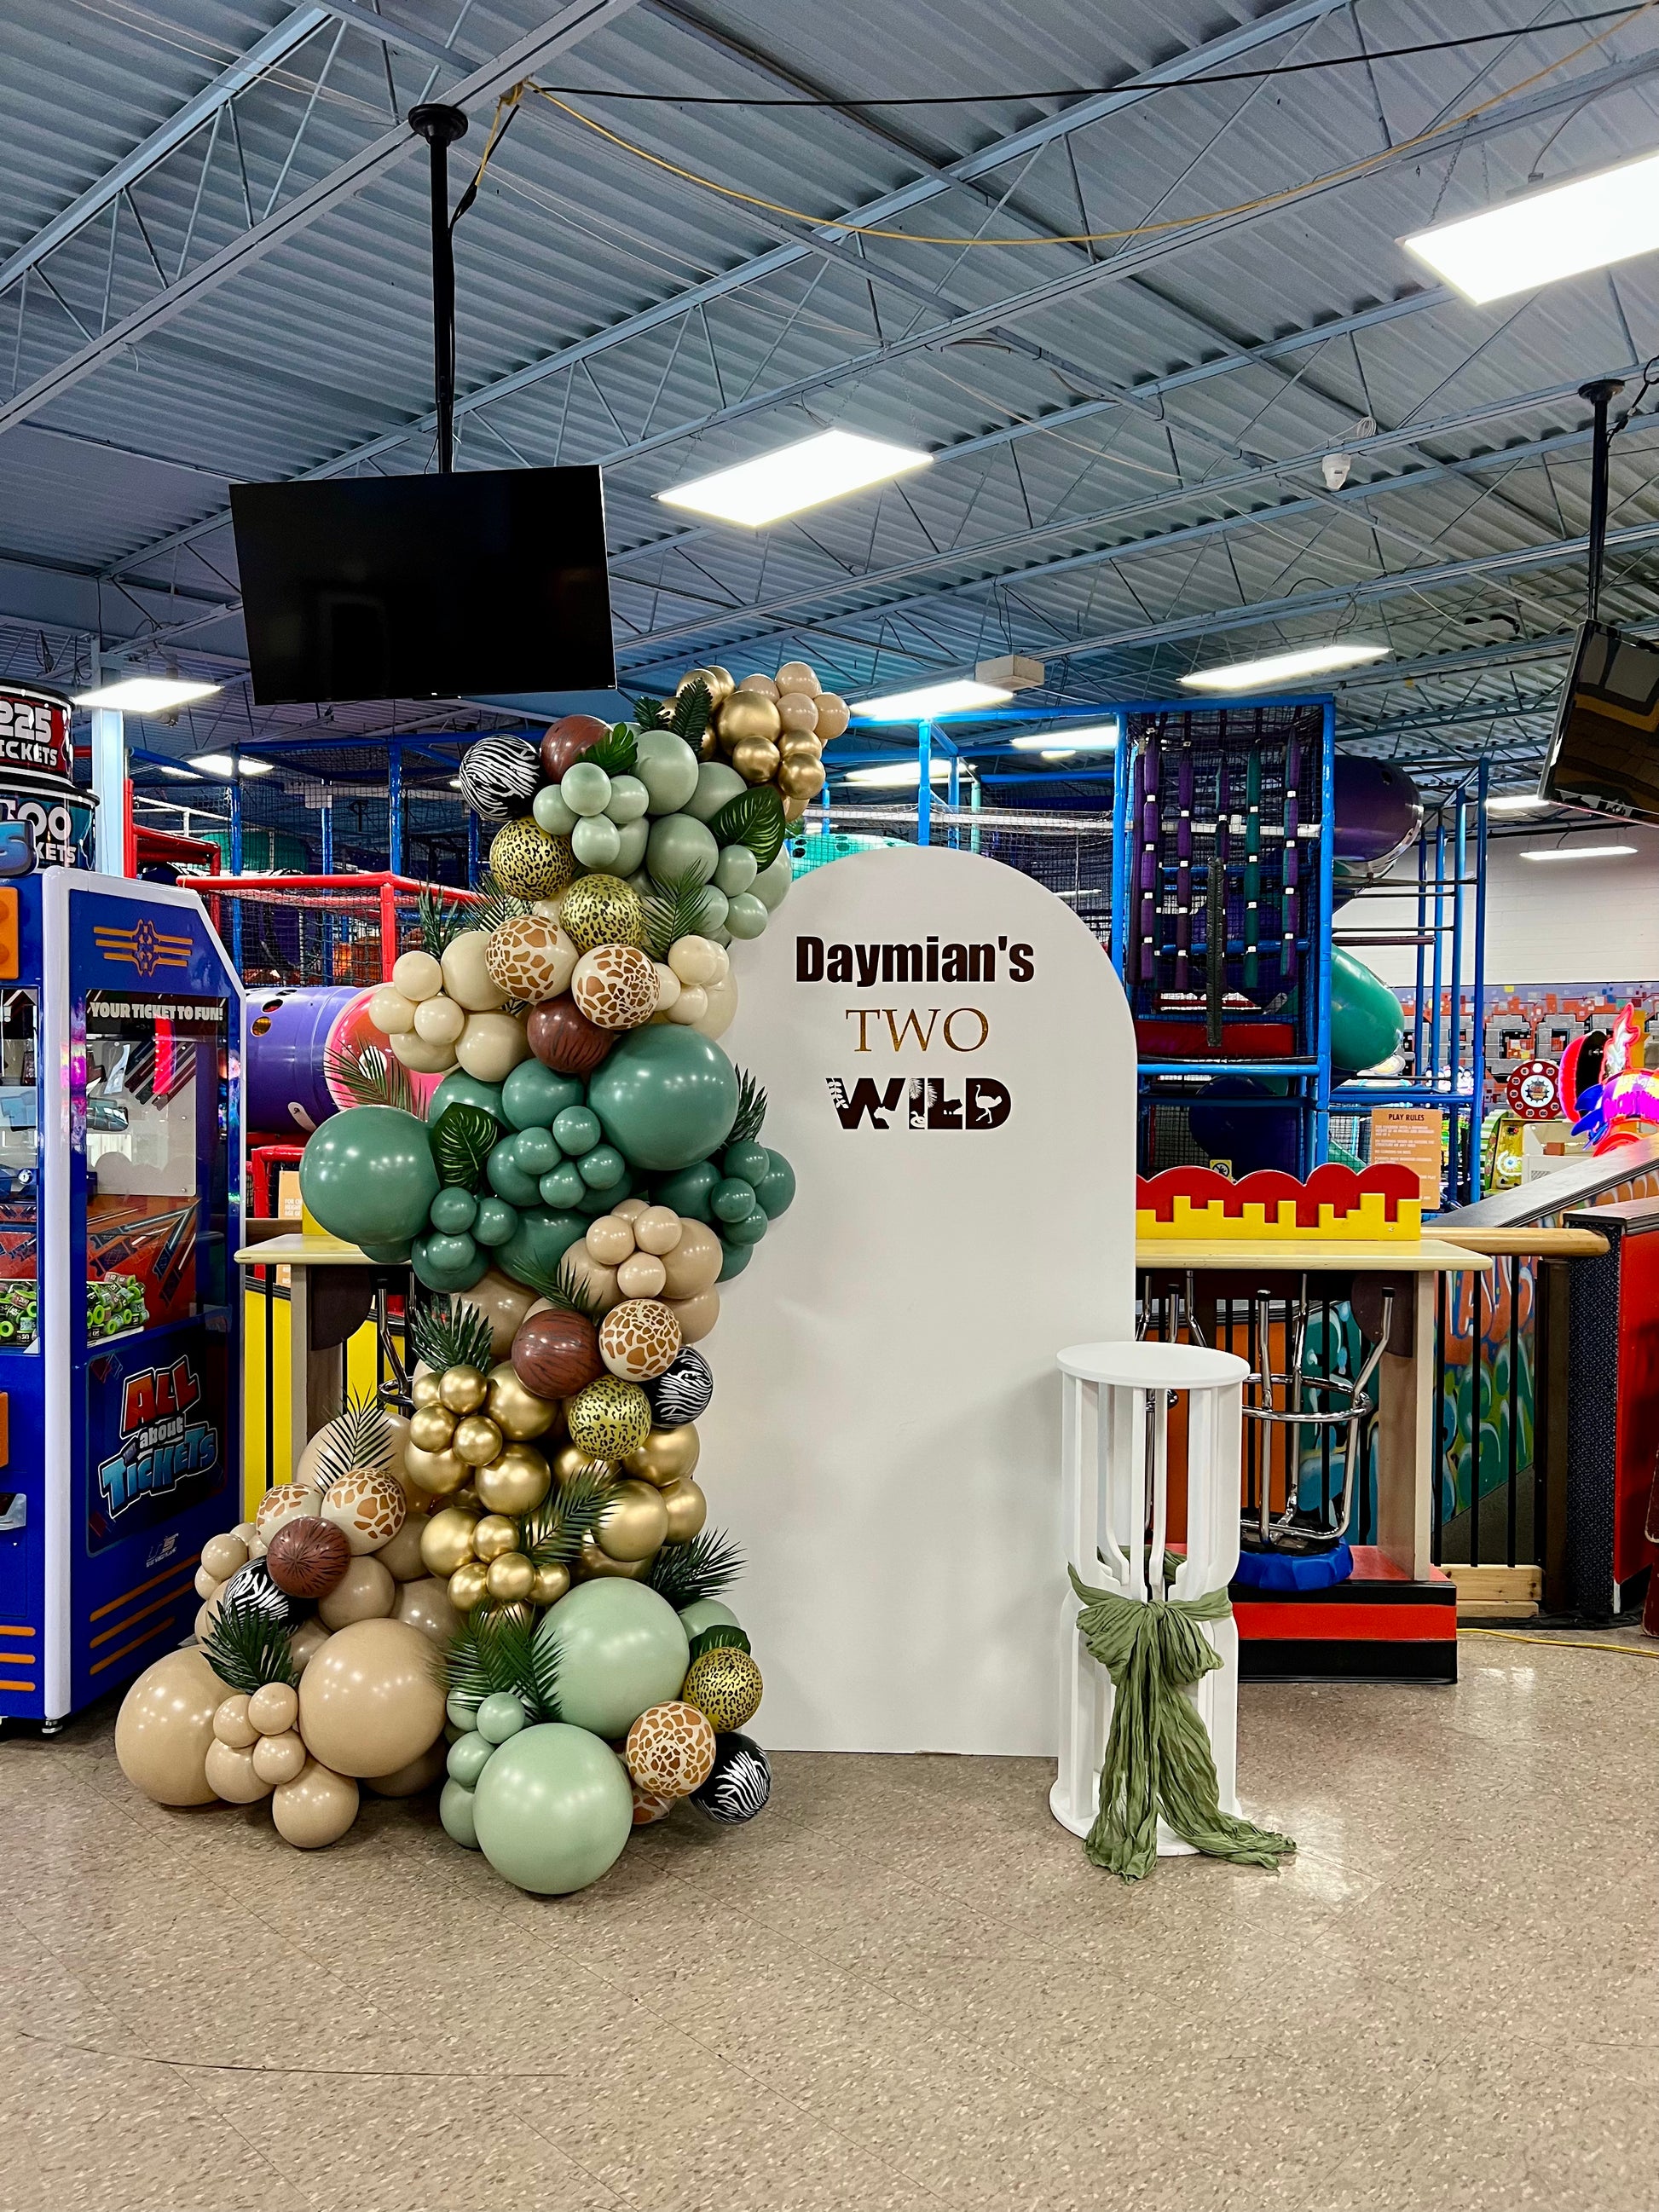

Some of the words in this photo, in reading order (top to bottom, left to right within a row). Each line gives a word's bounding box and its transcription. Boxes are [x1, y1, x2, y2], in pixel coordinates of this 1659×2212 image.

[0, 739, 58, 766] ICKETS
[35, 840, 77, 864] KETS
[795, 935, 1035, 988] Daymian's
[90, 1002, 130, 1019] YOUR
[131, 1003, 176, 1020] TICKET
[177, 1005, 194, 1020] TO
[194, 1006, 223, 1021] FUN!
[845, 1007, 990, 1053] TWO
[824, 1077, 1013, 1130] WILD
[1405, 1113, 1425, 1122] RULES
[123, 1360, 198, 1433] ALL
[139, 1415, 184, 1449] about
[101, 1425, 216, 1510] TICKETS
